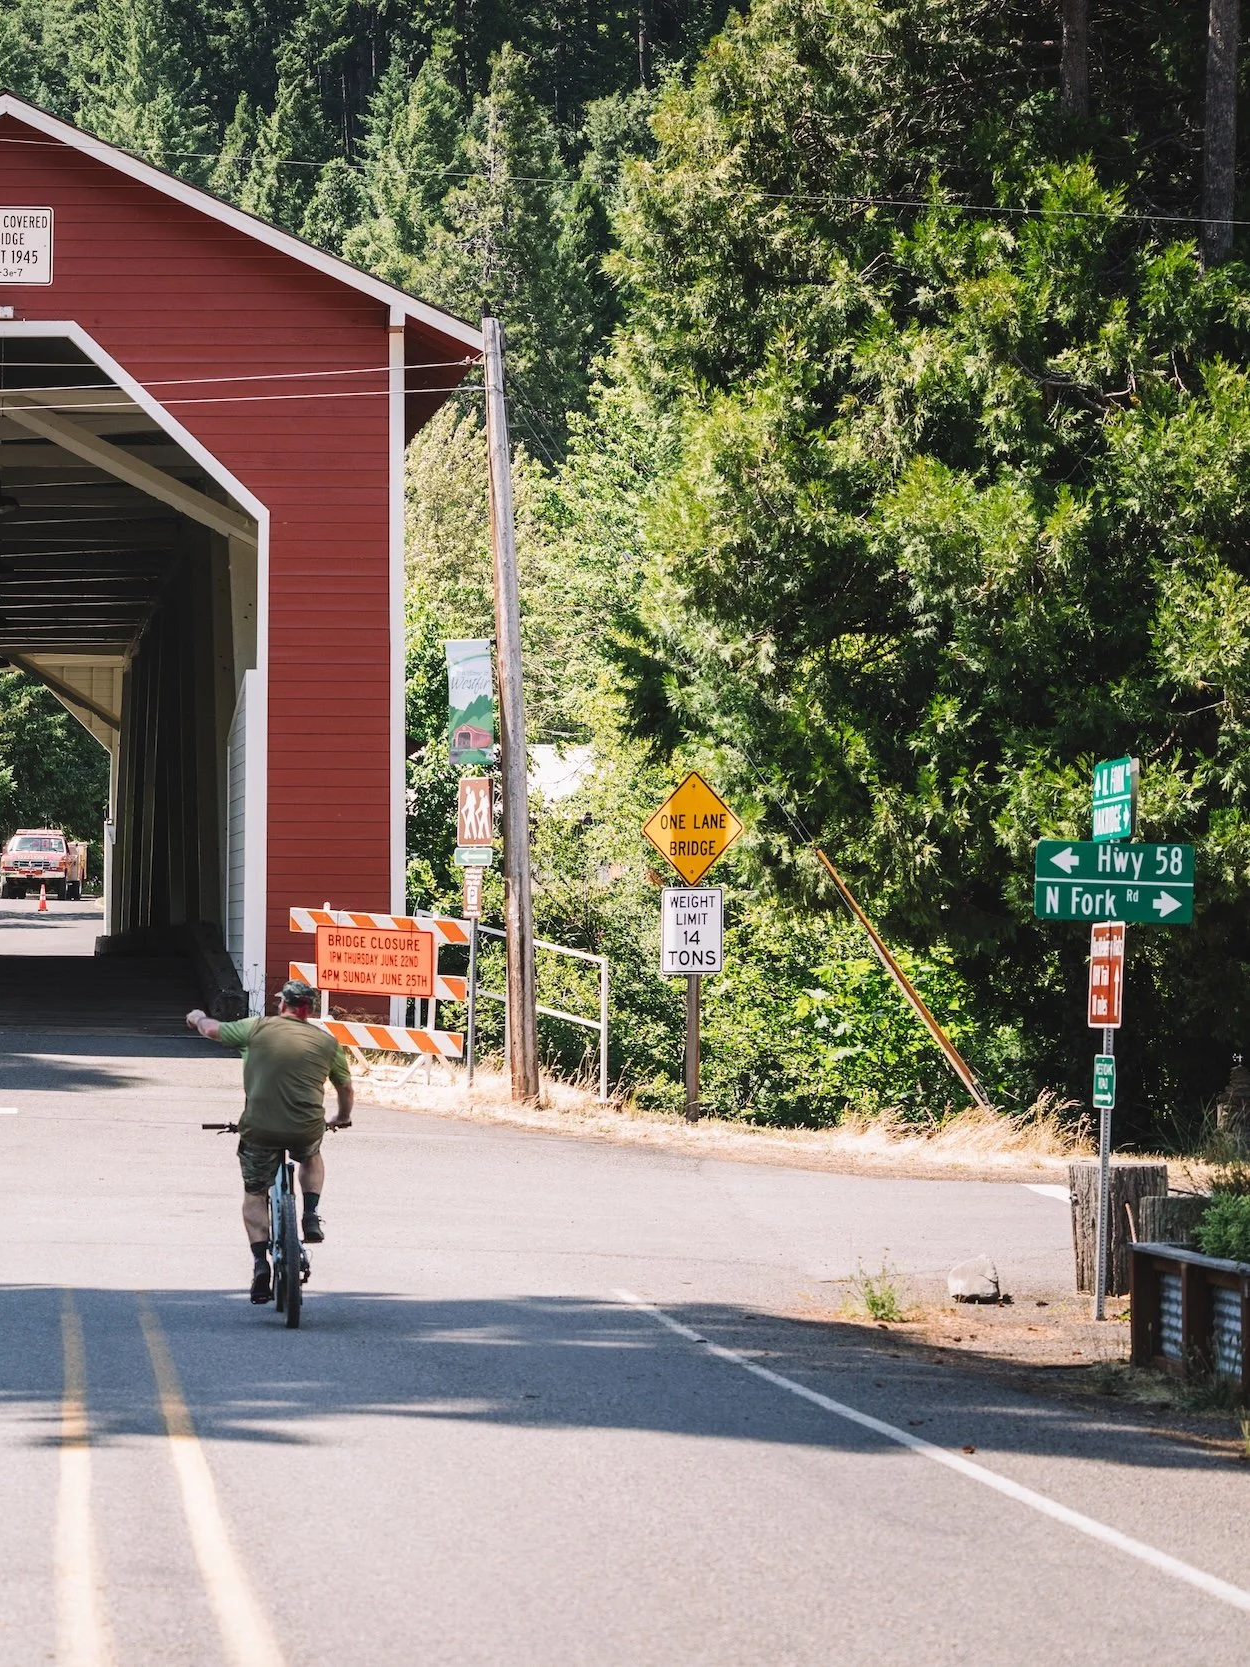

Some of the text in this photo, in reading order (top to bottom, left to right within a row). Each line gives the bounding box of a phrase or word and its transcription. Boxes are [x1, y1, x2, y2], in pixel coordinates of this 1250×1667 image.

[3, 215, 48, 229] COVERED
[11, 250, 38, 265] 1945
[451, 676, 490, 695] Westfir
[660, 812, 727, 831] ONE LANE
[669, 840, 716, 857] BRIDGE
[1097, 844, 1183, 881] Hwy 58
[669, 894, 716, 909] WEIGHT
[1045, 885, 1139, 918] N Fork Rd
[676, 912, 708, 926] LIMIT
[328, 934, 420, 952] BRIDGE CLOSURE
[683, 930, 701, 946] 14
[344, 952, 379, 966] THURSDAY
[380, 954, 398, 967] JUNE
[400, 955, 419, 968] 22ND
[668, 950, 717, 967] TONS
[321, 969, 428, 987] 4PM SUNDAY JUNE 25TH
